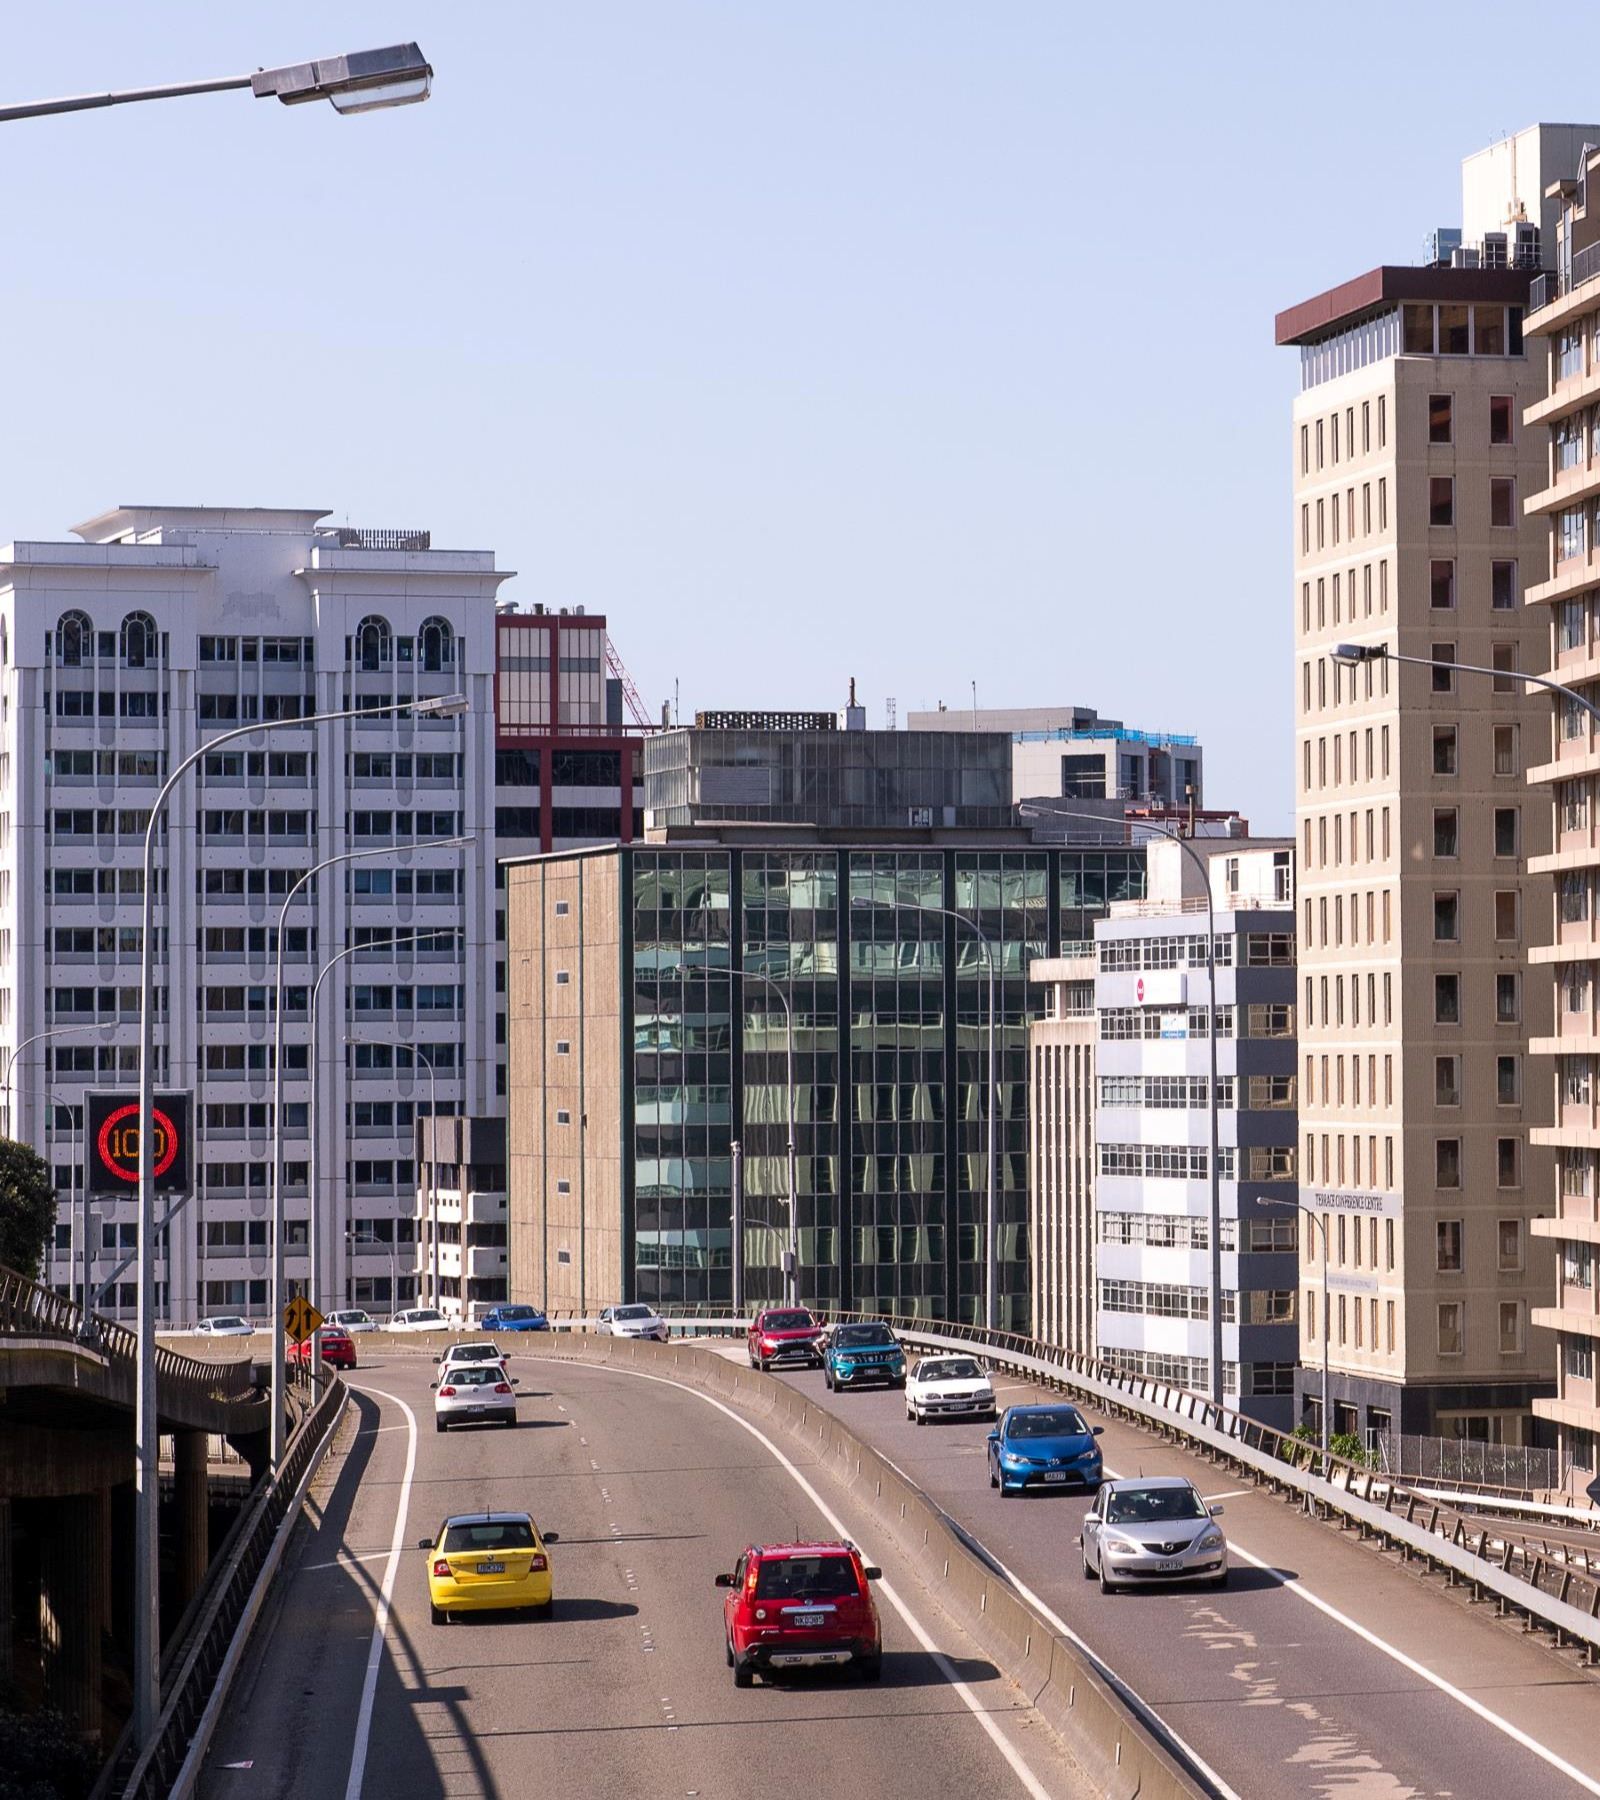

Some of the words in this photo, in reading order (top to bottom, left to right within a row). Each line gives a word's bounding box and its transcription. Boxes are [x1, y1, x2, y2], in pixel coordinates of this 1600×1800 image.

[1315, 1193, 1335, 1207] TERRACE
[1336, 1194, 1364, 1209] CONFERENCE
[1365, 1196, 1383, 1211] CENTRE
